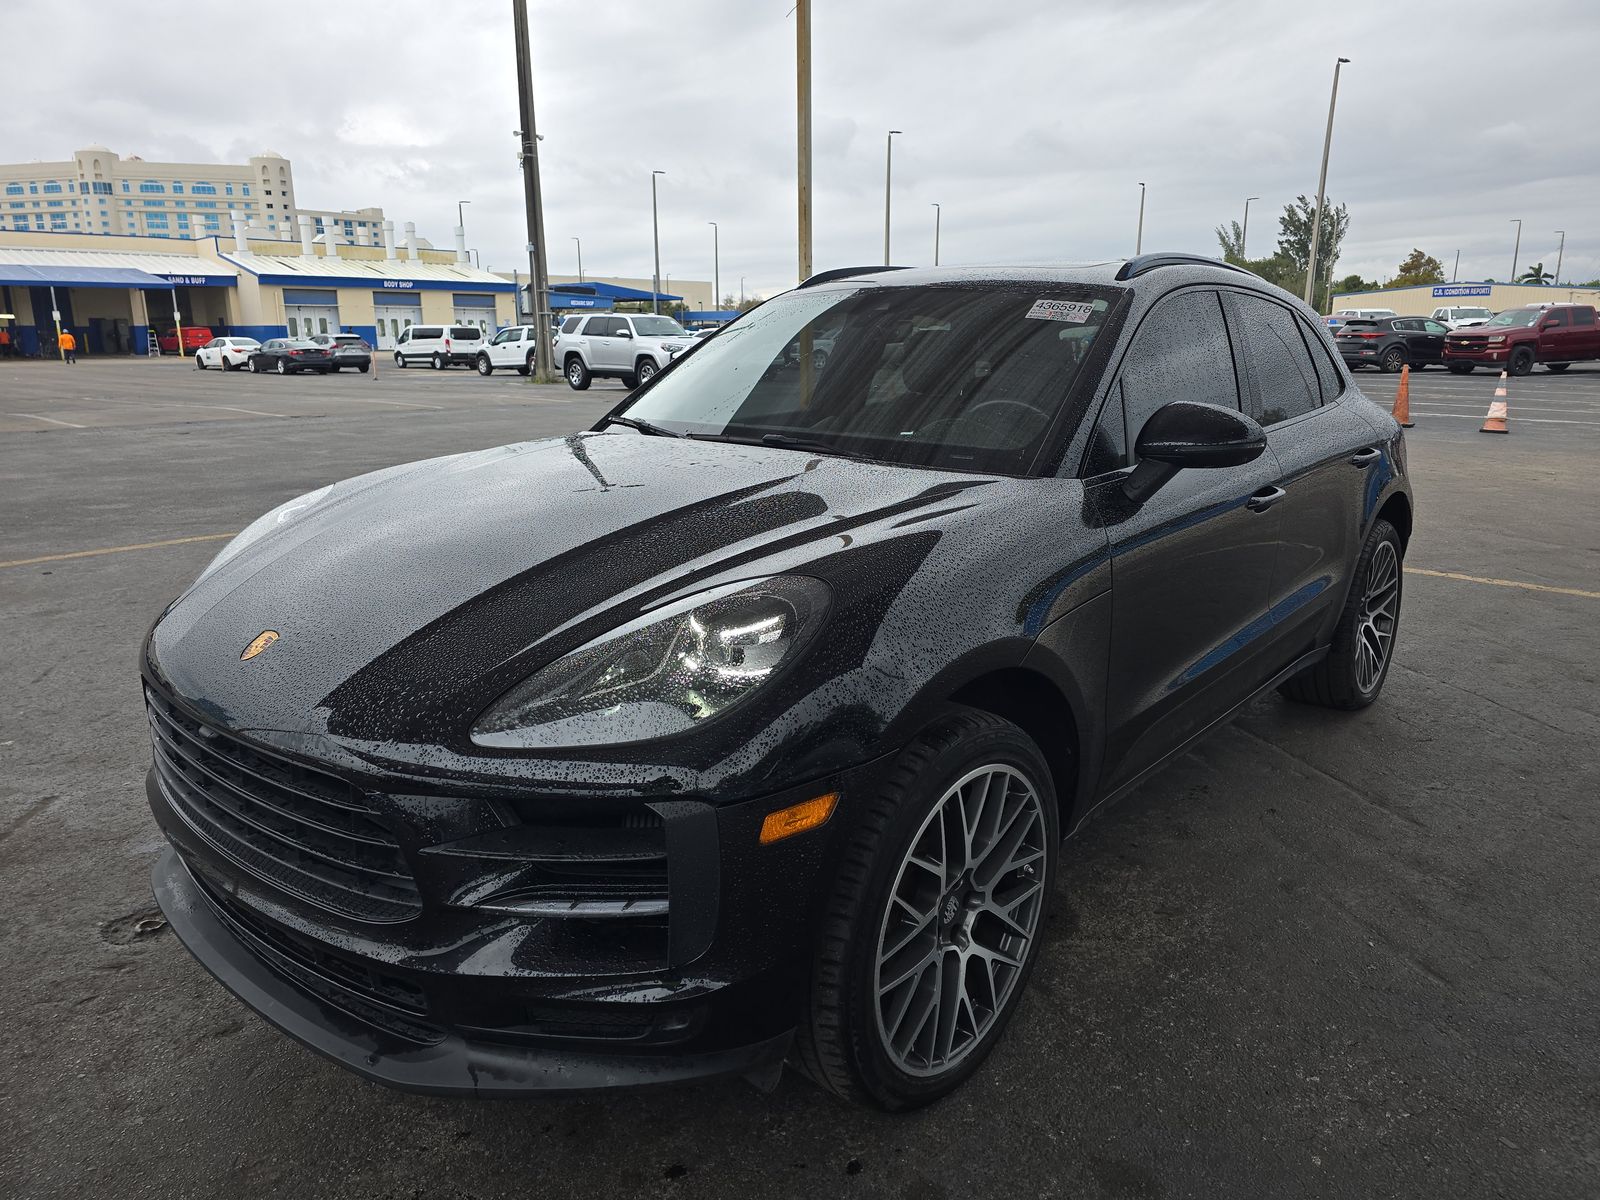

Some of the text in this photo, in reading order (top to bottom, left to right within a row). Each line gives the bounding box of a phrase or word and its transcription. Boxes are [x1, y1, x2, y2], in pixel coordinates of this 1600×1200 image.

[168, 276, 184, 284] SAND
[383, 280, 398, 288] BODY
[1036, 302, 1093, 313] 4365918
